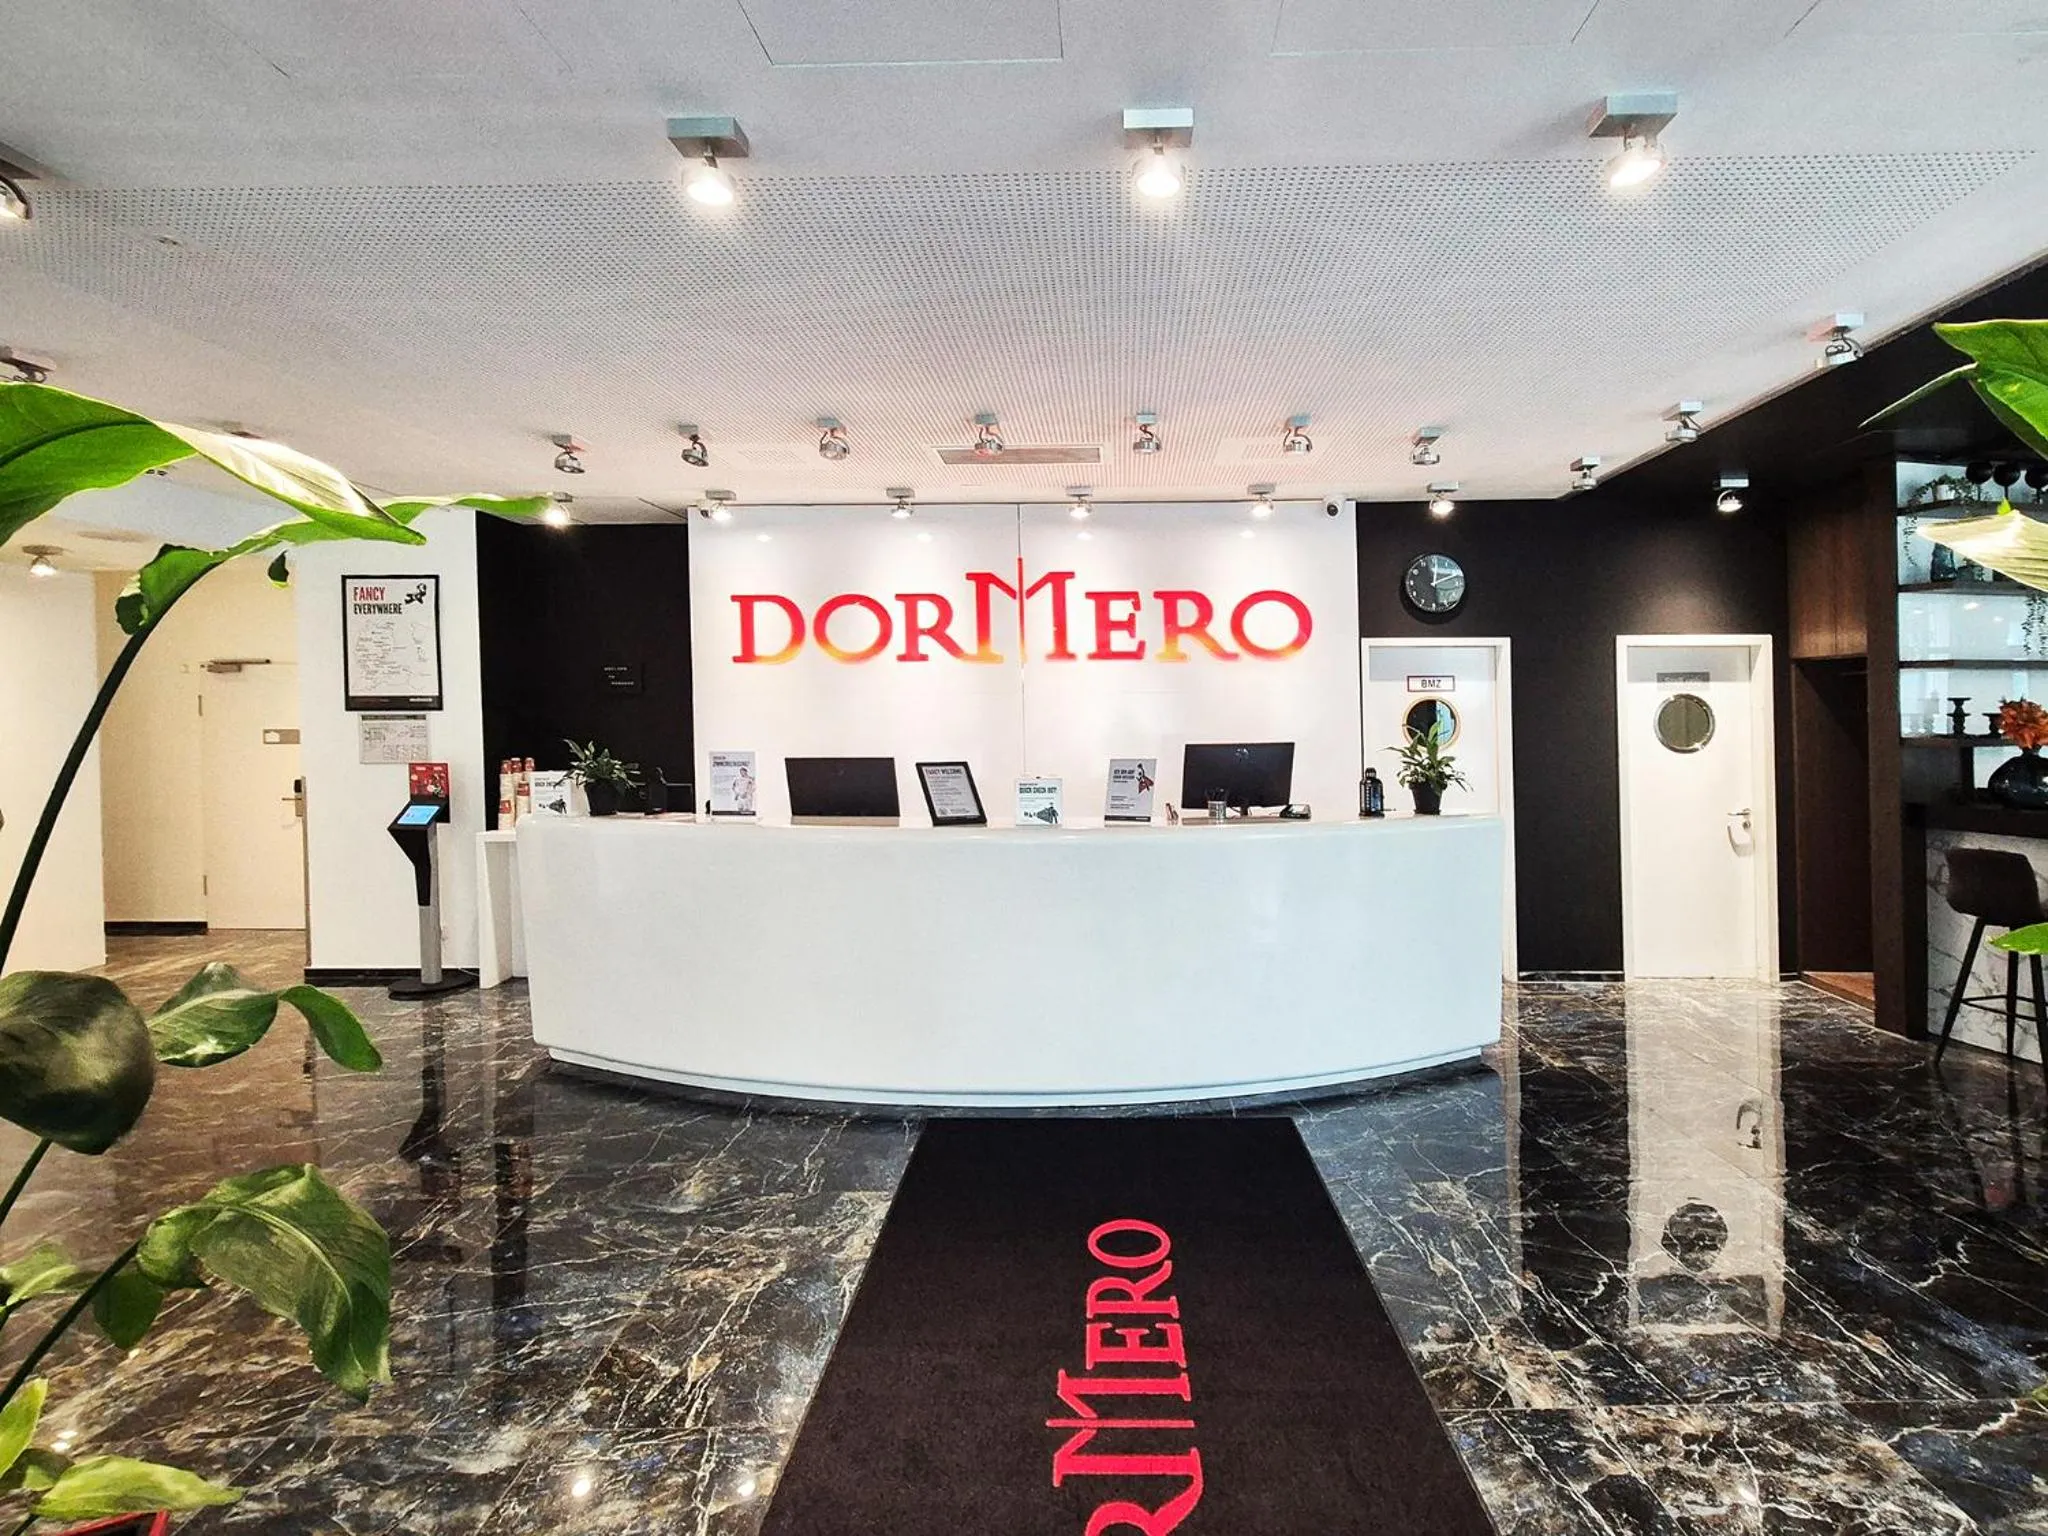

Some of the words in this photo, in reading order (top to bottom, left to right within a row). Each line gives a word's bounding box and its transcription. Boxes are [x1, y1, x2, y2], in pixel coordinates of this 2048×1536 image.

[353, 587, 385, 601] FANCY
[353, 603, 402, 615] EVERYWHERE
[730, 557, 1312, 667] DORMERO
